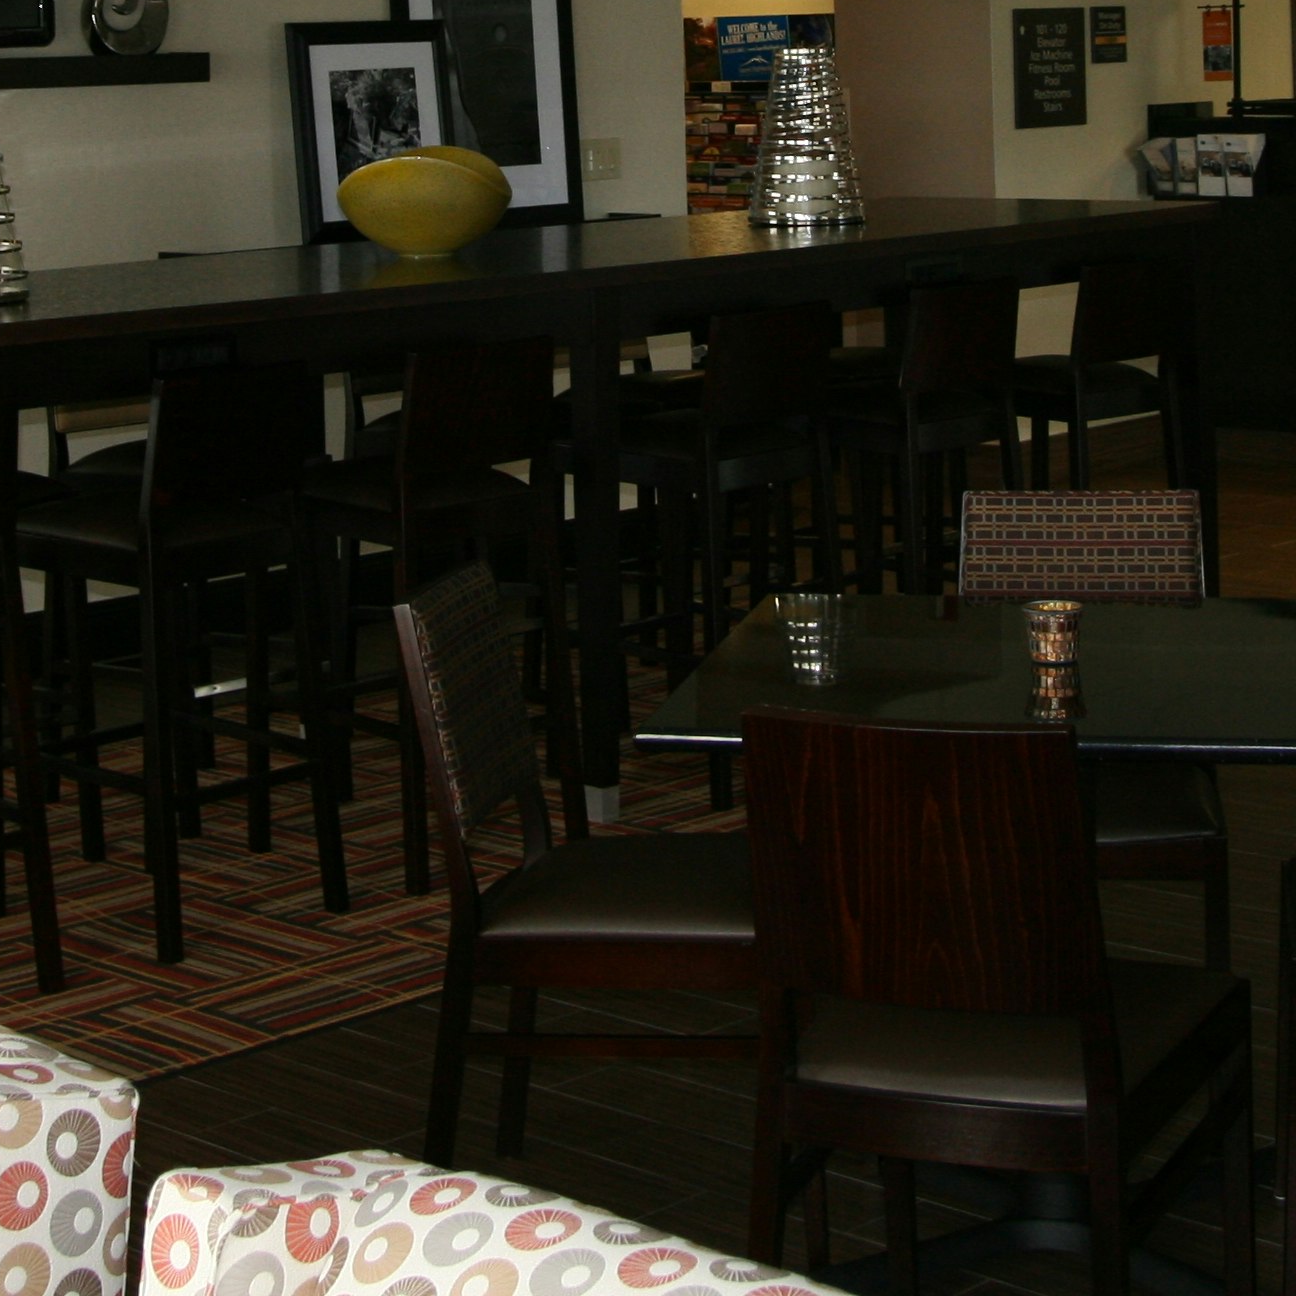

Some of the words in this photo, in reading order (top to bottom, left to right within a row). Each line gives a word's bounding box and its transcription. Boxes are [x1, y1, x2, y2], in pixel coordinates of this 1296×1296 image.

[727, 22, 759, 35] WELCOME
[1056, 23, 1068, 35] 120
[1036, 37, 1068, 48] Elevator
[1030, 50, 1041, 61] Ice
[1042, 49, 1074, 61] Machine
[1028, 63, 1053, 74] Fitness
[1054, 62, 1076, 73] Room
[1044, 75, 1061, 86] Pool
[1033, 89, 1072, 100] Restrooms
[1042, 101, 1063, 113] Stairs
